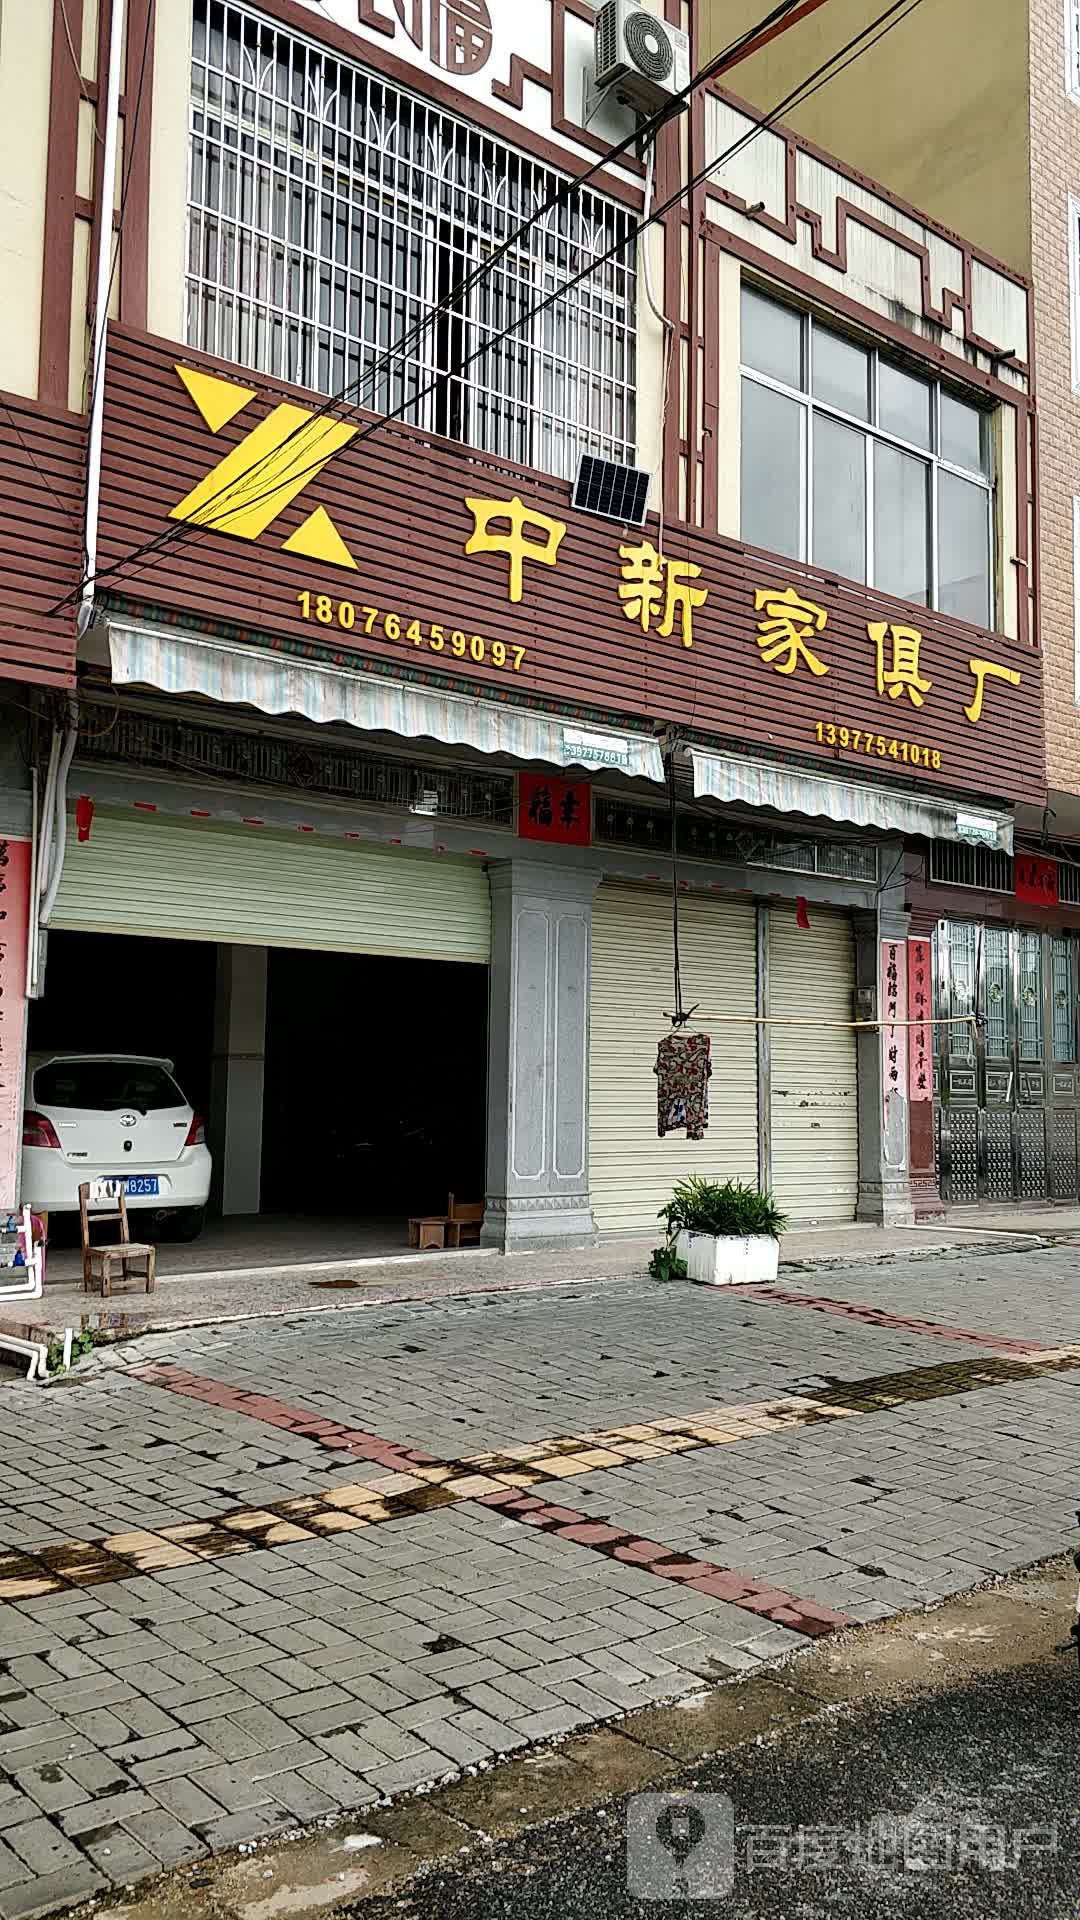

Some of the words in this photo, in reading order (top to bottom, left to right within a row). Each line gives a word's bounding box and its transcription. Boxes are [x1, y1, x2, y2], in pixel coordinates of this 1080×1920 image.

[297, 590, 526, 671] 18076459097
[465, 496, 1021, 722] 中新家俱厂
[815, 721, 941, 769] 13977541018
